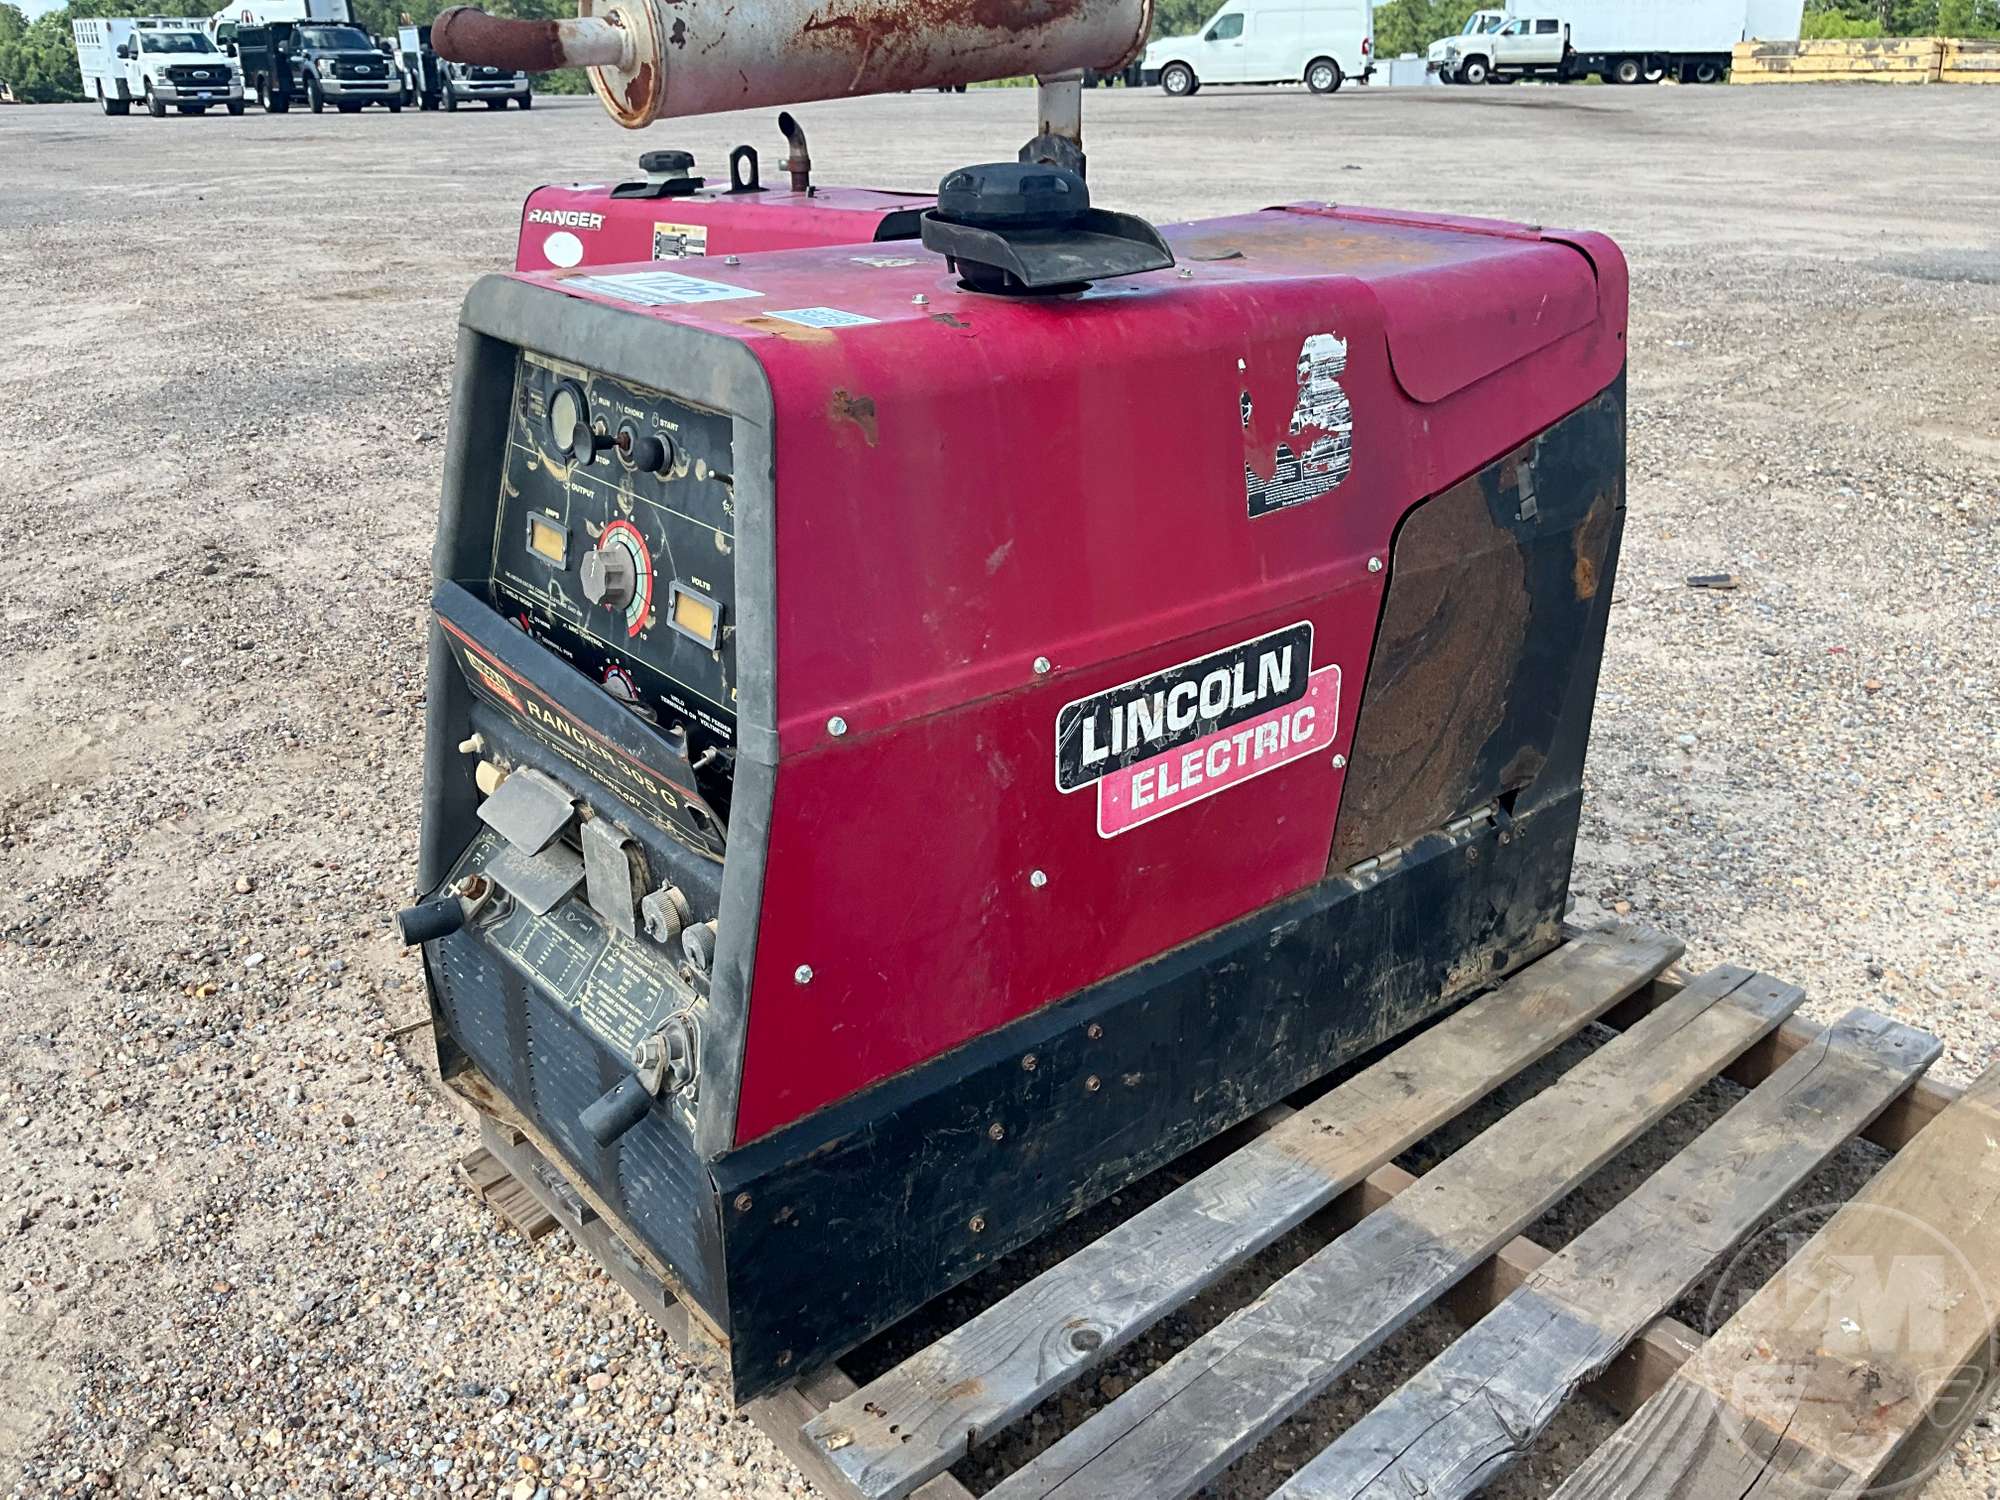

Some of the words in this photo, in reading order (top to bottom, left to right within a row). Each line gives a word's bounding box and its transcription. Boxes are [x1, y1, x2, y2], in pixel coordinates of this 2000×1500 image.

[528, 209, 603, 230] RANGER
[598, 397, 610, 407] RUN
[624, 406, 644, 420] CHOKE
[660, 418, 679, 432] START
[596, 454, 610, 466] STOP
[571, 484, 595, 499] OUTPUT
[691, 576, 711, 591] VOLTS
[639, 631, 648, 641] 10
[1082, 645, 1293, 767] LINCOLN
[700, 719, 730, 740] VOLTMETER
[711, 717, 732, 734] FEEDER
[526, 699, 617, 767] RANGER
[617, 760, 658, 795] 305
[659, 789, 679, 809] G
[1131, 706, 1316, 811] ELECTRIC
[588, 767, 641, 807] TECHNOLOGY
